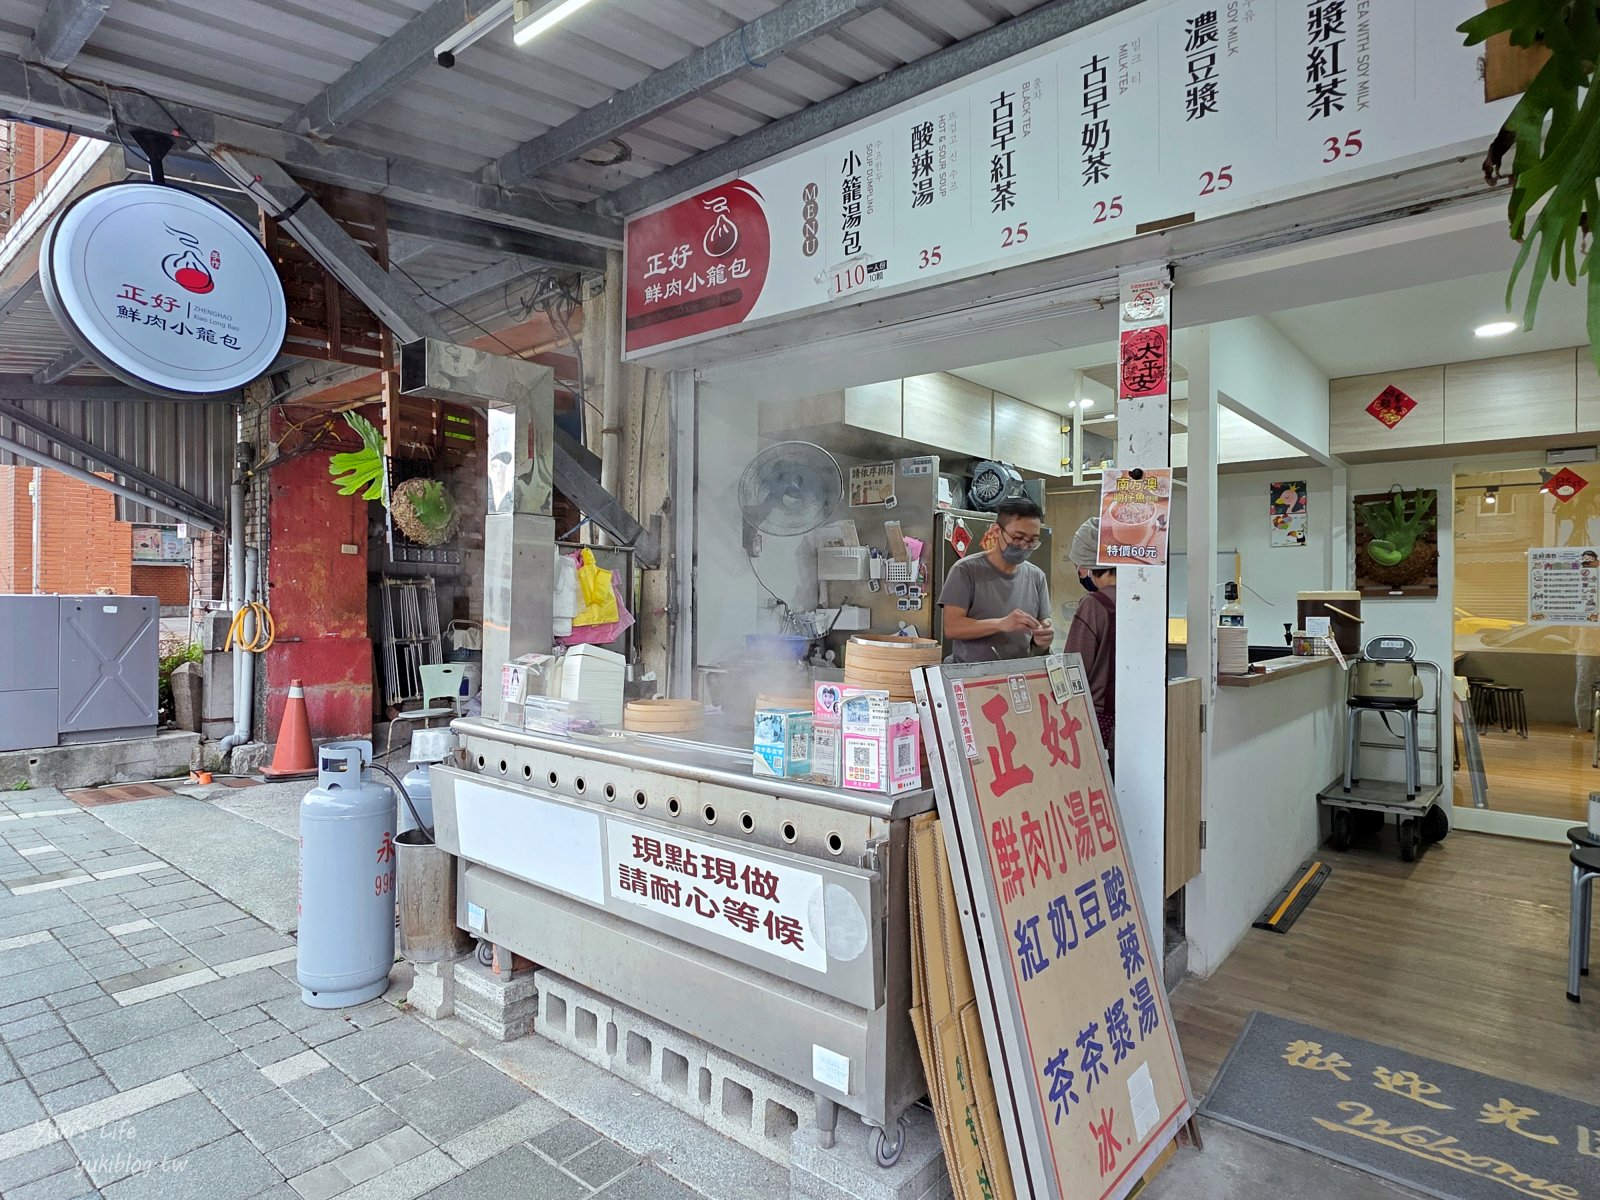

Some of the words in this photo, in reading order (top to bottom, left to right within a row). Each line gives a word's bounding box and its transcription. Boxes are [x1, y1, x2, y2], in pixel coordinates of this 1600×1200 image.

[1227, 2, 1239, 23] SOY
[1357, 0, 1370, 19] EA
[1227, 26, 1239, 57] MILK
[1357, 20, 1370, 52] WITH
[1118, 44, 1128, 73] MILK
[1185, 10, 1219, 122] 濃豆漿
[1307, 0, 1348, 121] 漿紅茶
[1357, 56, 1370, 77] SOY
[1022, 82, 1031, 116] BLACK
[1118, 74, 1128, 95] TEA
[1357, 80, 1370, 112] MILK
[938, 114, 947, 133] HOT
[1022, 117, 1032, 138] TEA
[1080, 55, 1111, 187] 古早奶茶
[866, 143, 874, 166] SOUP
[938, 145, 947, 170] SOUR
[990, 91, 1017, 213] 古早紅茶
[1322, 129, 1363, 163] 35
[911, 121, 935, 208] 酸辣湯
[866, 170, 874, 215] DUMPLING
[938, 173, 947, 197] SOUP
[1199, 165, 1233, 196] 25
[841, 150, 862, 256] 小籠湯包
[1092, 195, 1123, 224] 25
[803, 184, 818, 256] MENU
[1001, 222, 1029, 248] 25
[644, 244, 693, 279] 正好
[867, 262, 887, 272] 一人份
[919, 246, 942, 269] 35
[644, 258, 751, 305] 鮮肉小籠包
[834, 264, 865, 294] 110
[116, 284, 181, 313] 正好
[193, 305, 233, 321] ZHENGHAO
[116, 305, 241, 350] 鮮肉小籠包
[193, 313, 208, 323] Xiao
[209, 318, 226, 329] Long
[227, 322, 240, 332] Bao
[1106, 545, 1157, 558] 特價60元
[981, 691, 1084, 798] 正好
[992, 786, 1117, 905] 鮮肉小湯包
[631, 834, 780, 903] 現點現做
[618, 863, 804, 951] 請耐心等候
[1281, 1039, 1600, 1157] 歡迎光
